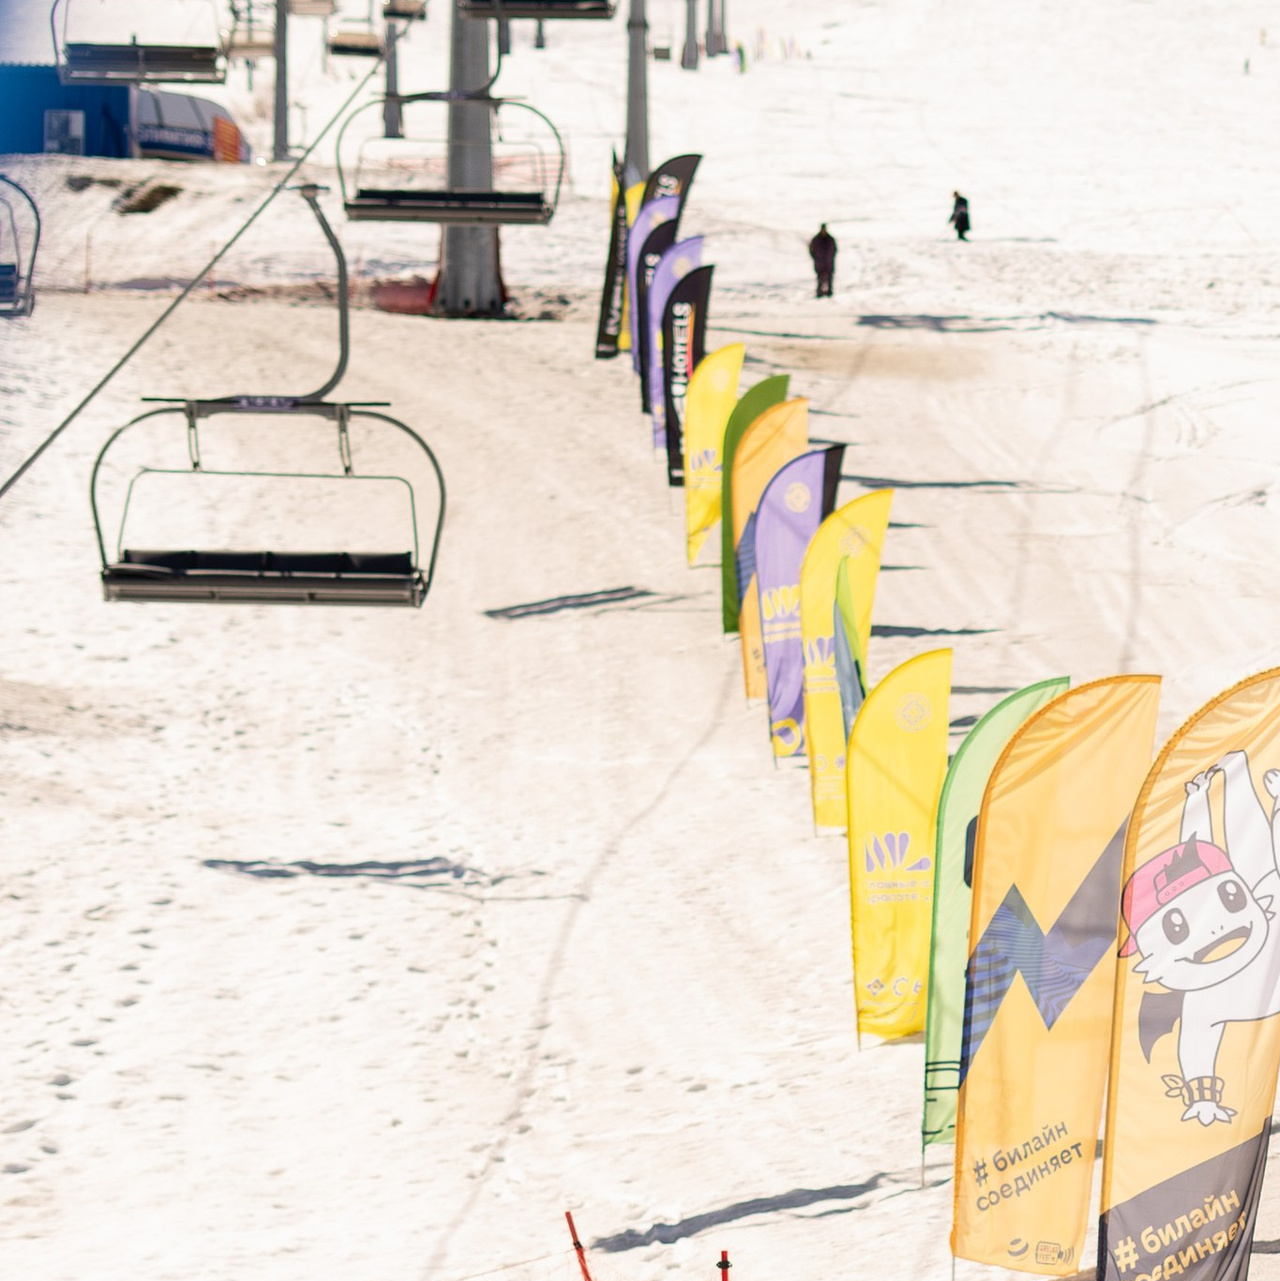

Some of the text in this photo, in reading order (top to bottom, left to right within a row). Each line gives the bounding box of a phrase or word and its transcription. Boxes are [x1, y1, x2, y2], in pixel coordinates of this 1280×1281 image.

[976, 1142, 1083, 1211] соединяет
[992, 1121, 1068, 1172] билайн
[1141, 1189, 1241, 1254] билайн
